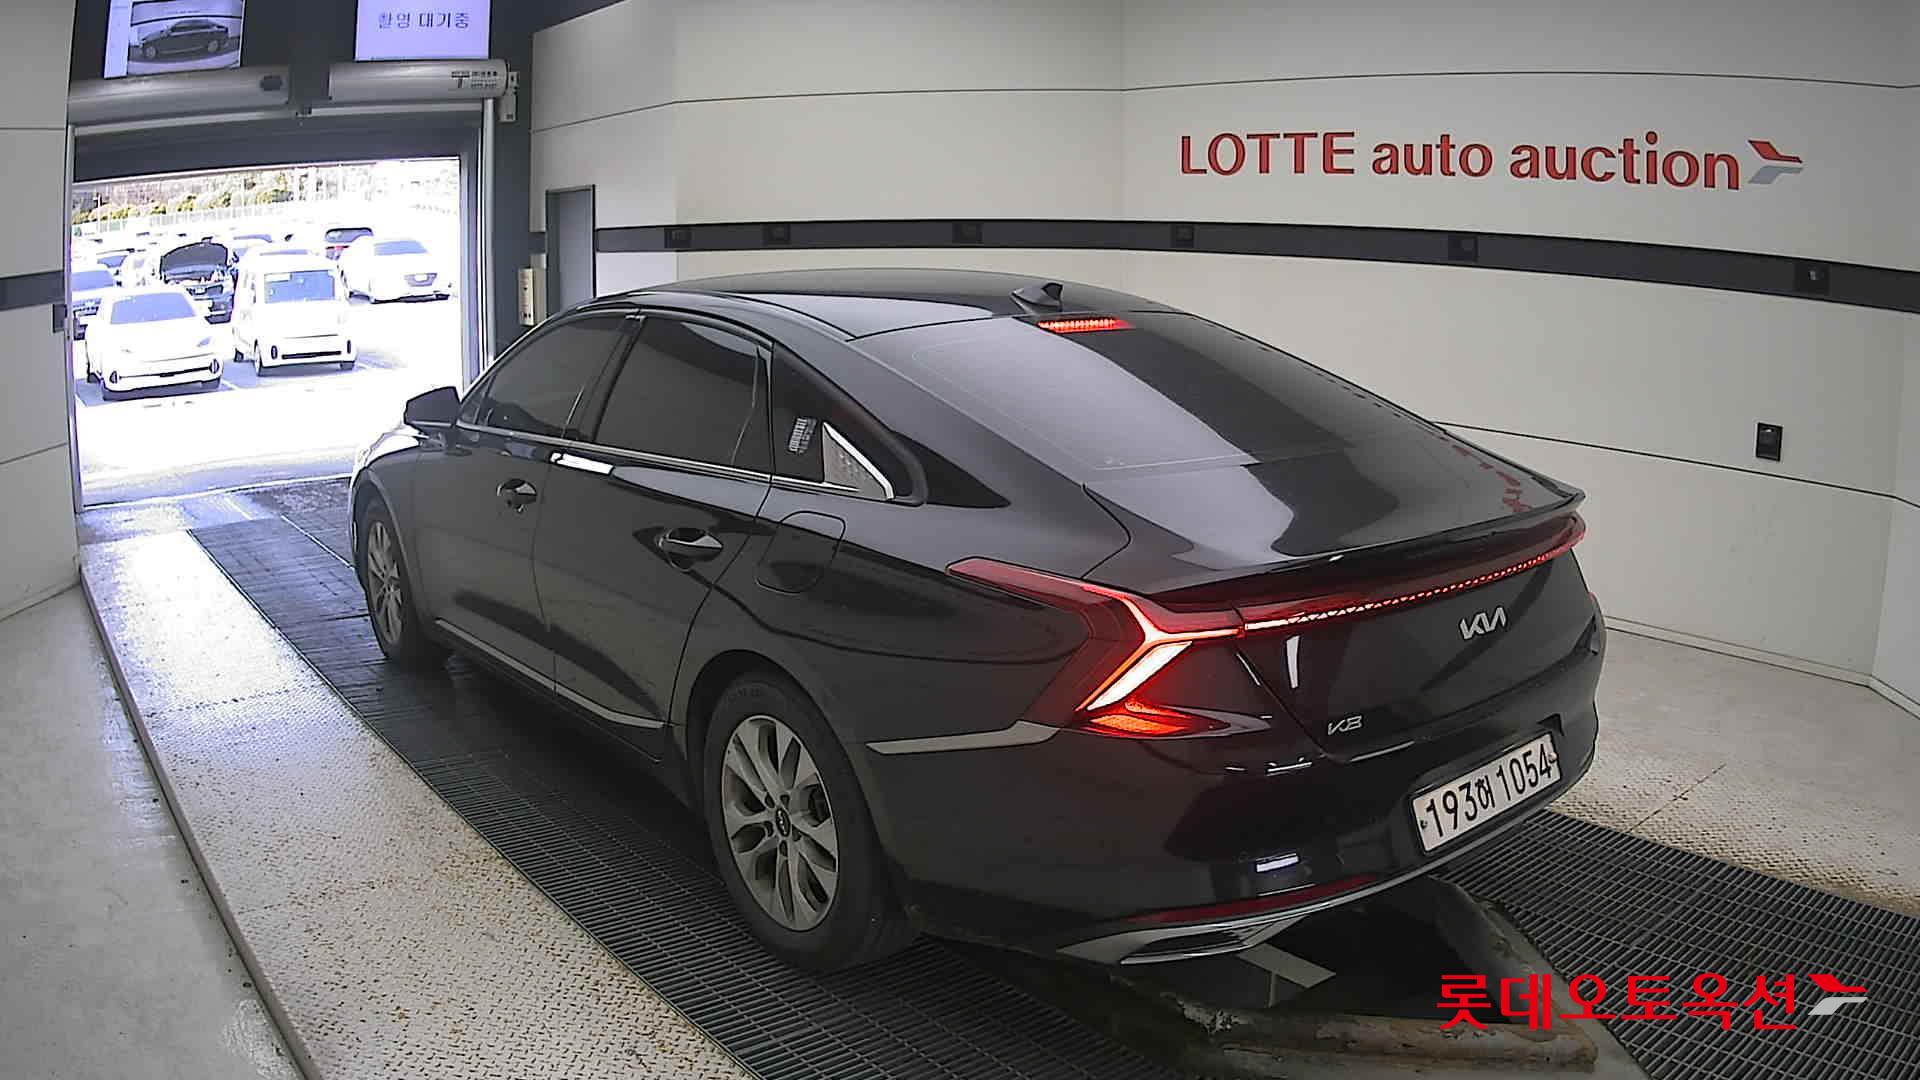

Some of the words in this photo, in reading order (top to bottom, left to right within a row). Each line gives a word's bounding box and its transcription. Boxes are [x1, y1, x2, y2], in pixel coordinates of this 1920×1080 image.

[418, 12, 470, 28] 대기중
[1181, 131, 1355, 176] LOTTE
[1372, 133, 1493, 177] auto
[1510, 131, 1740, 191] auction
[1426, 766, 1495, 838] 193허
[1496, 743, 1551, 801] 1054
